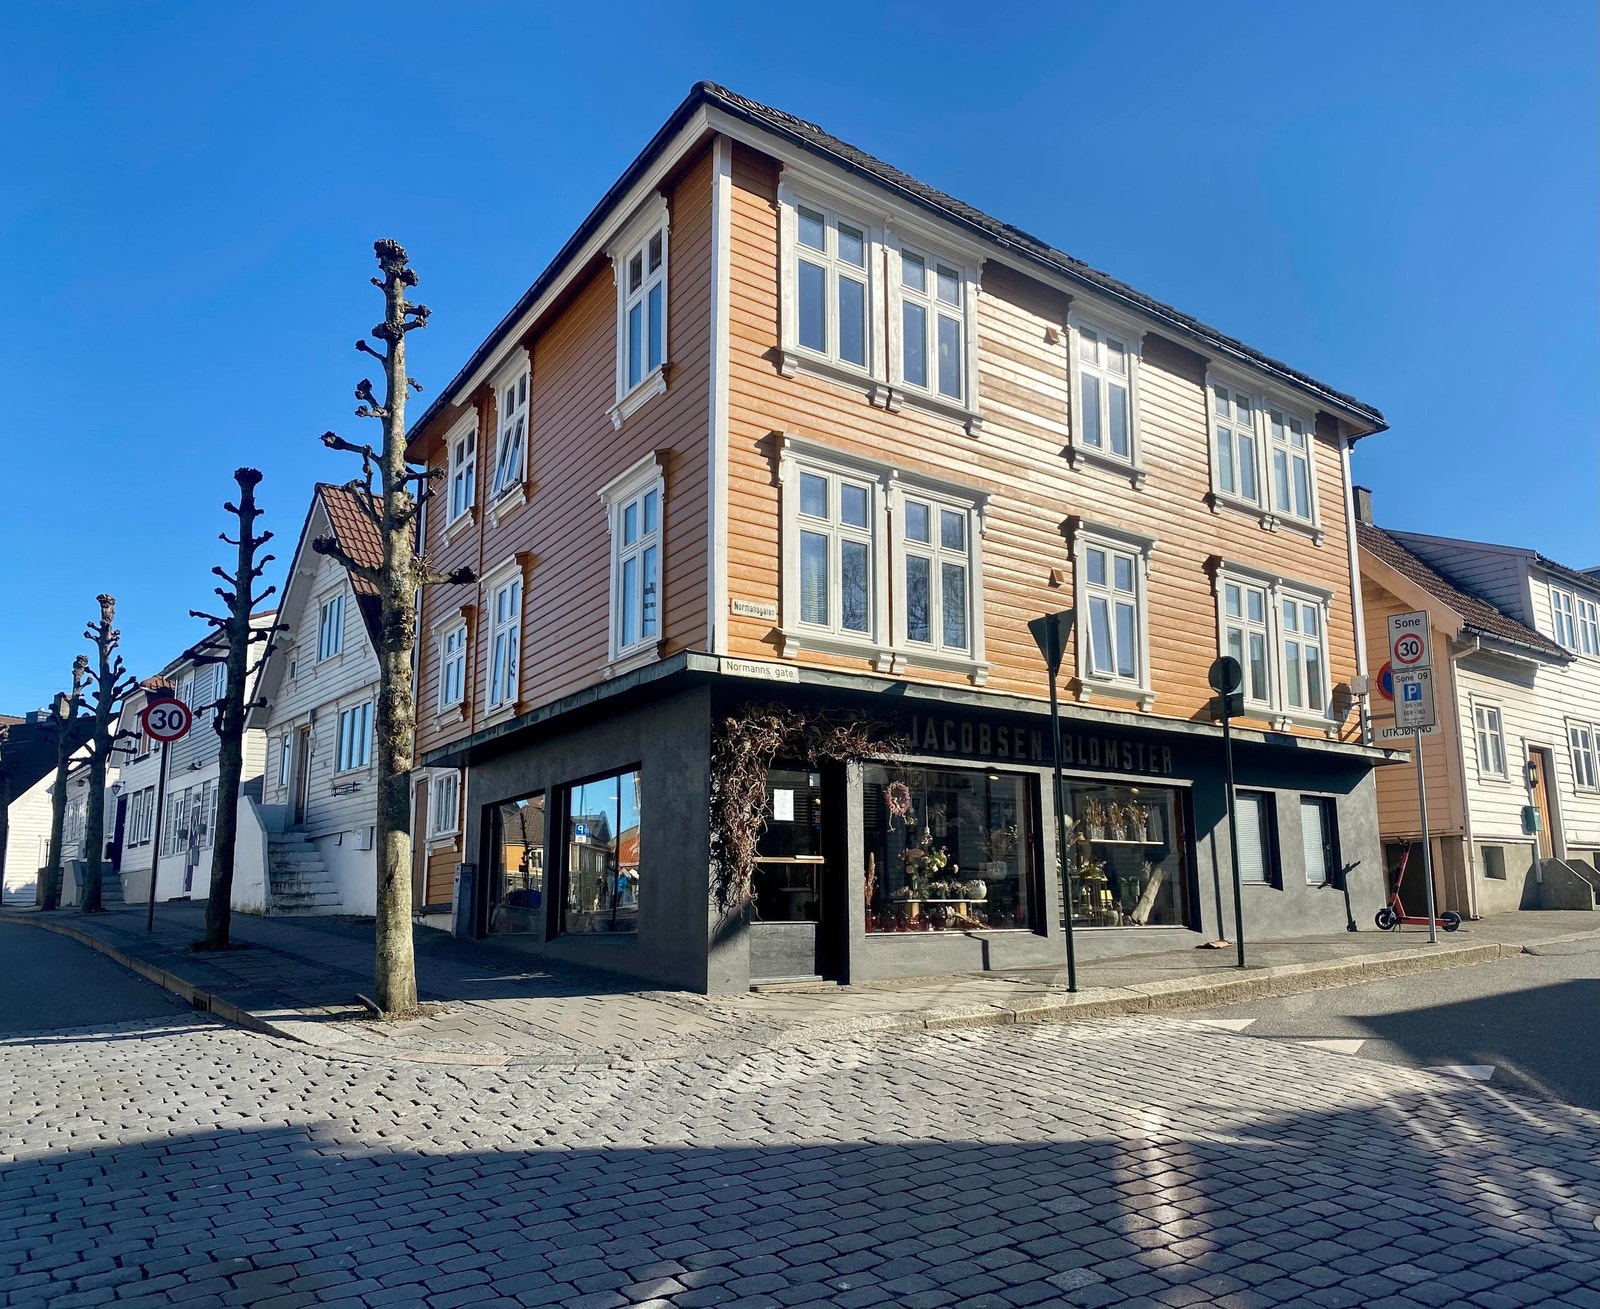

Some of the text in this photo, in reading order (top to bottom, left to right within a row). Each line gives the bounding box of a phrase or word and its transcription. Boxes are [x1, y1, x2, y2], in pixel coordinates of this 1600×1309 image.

[1394, 618, 1421, 629] Sone
[1400, 640, 1419, 657] 30
[726, 661, 794, 678] Normanns gate
[1396, 672, 1428, 683] Sone 09
[1408, 686, 1416, 699] P
[151, 709, 184, 730] 30
[906, 715, 1173, 774] JACOBSEN BLOMSTER
